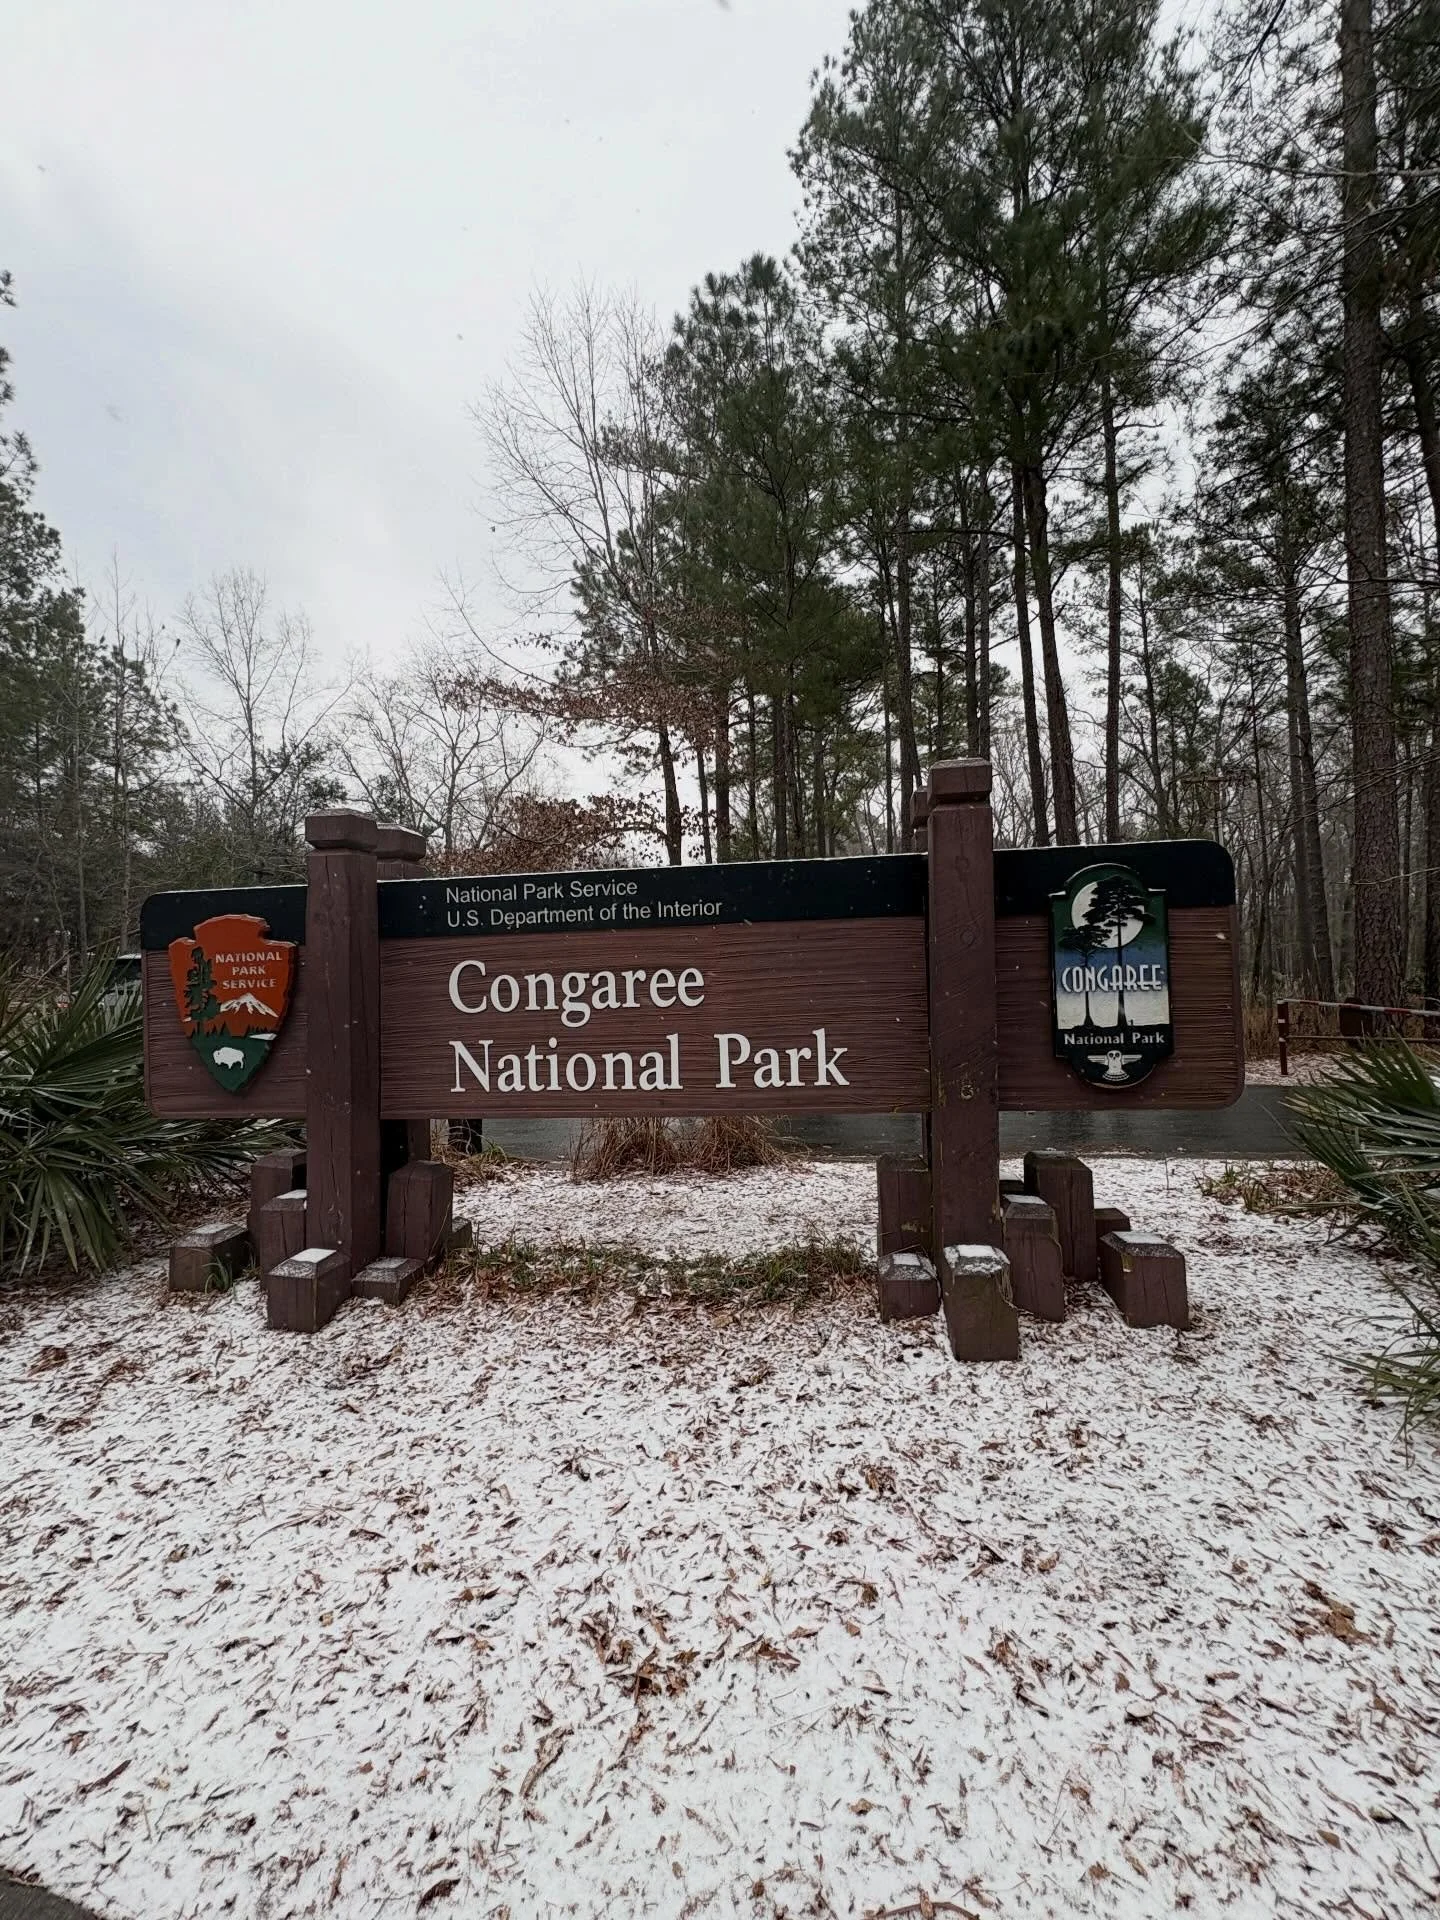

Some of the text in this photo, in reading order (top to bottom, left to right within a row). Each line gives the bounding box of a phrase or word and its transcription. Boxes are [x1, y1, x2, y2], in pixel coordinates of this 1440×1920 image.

[445, 879, 638, 904] National Park Service
[447, 899, 723, 929] U.S. Department of the Interior
[215, 951, 283, 963] NATIONAL
[232, 965, 266, 976] PARK
[1061, 964, 1162, 993] CONGAREE
[222, 978, 277, 990] SERVICE
[449, 959, 706, 1028] Congaree
[1064, 1031, 1165, 1045] National Park
[449, 1027, 850, 1093] National Park
